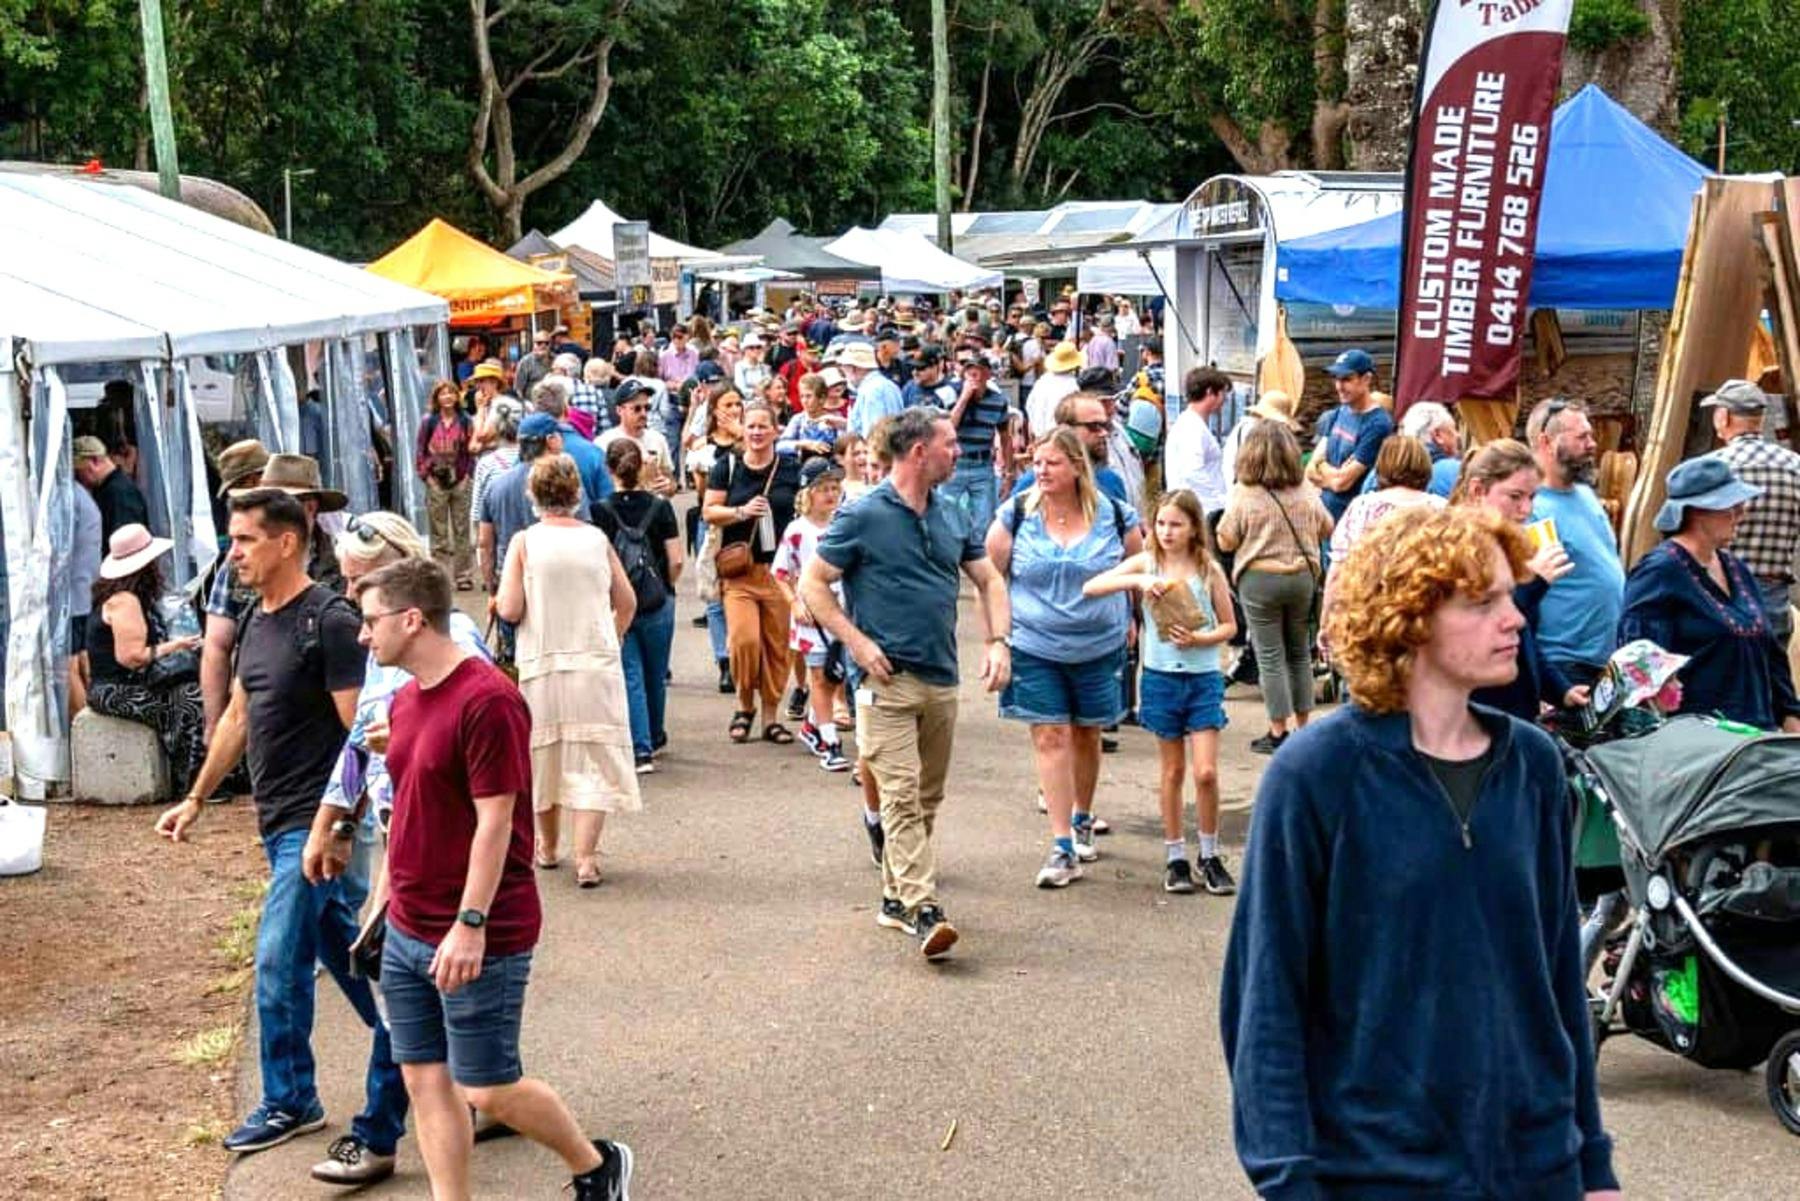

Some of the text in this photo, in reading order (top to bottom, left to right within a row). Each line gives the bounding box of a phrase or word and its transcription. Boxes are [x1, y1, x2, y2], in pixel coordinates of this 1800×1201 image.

[1414, 106, 1466, 339] CUSTOM MADE
[1442, 72, 1505, 377] TIMBER FURNITURE
[1487, 124, 1539, 345] 0414 768 526
